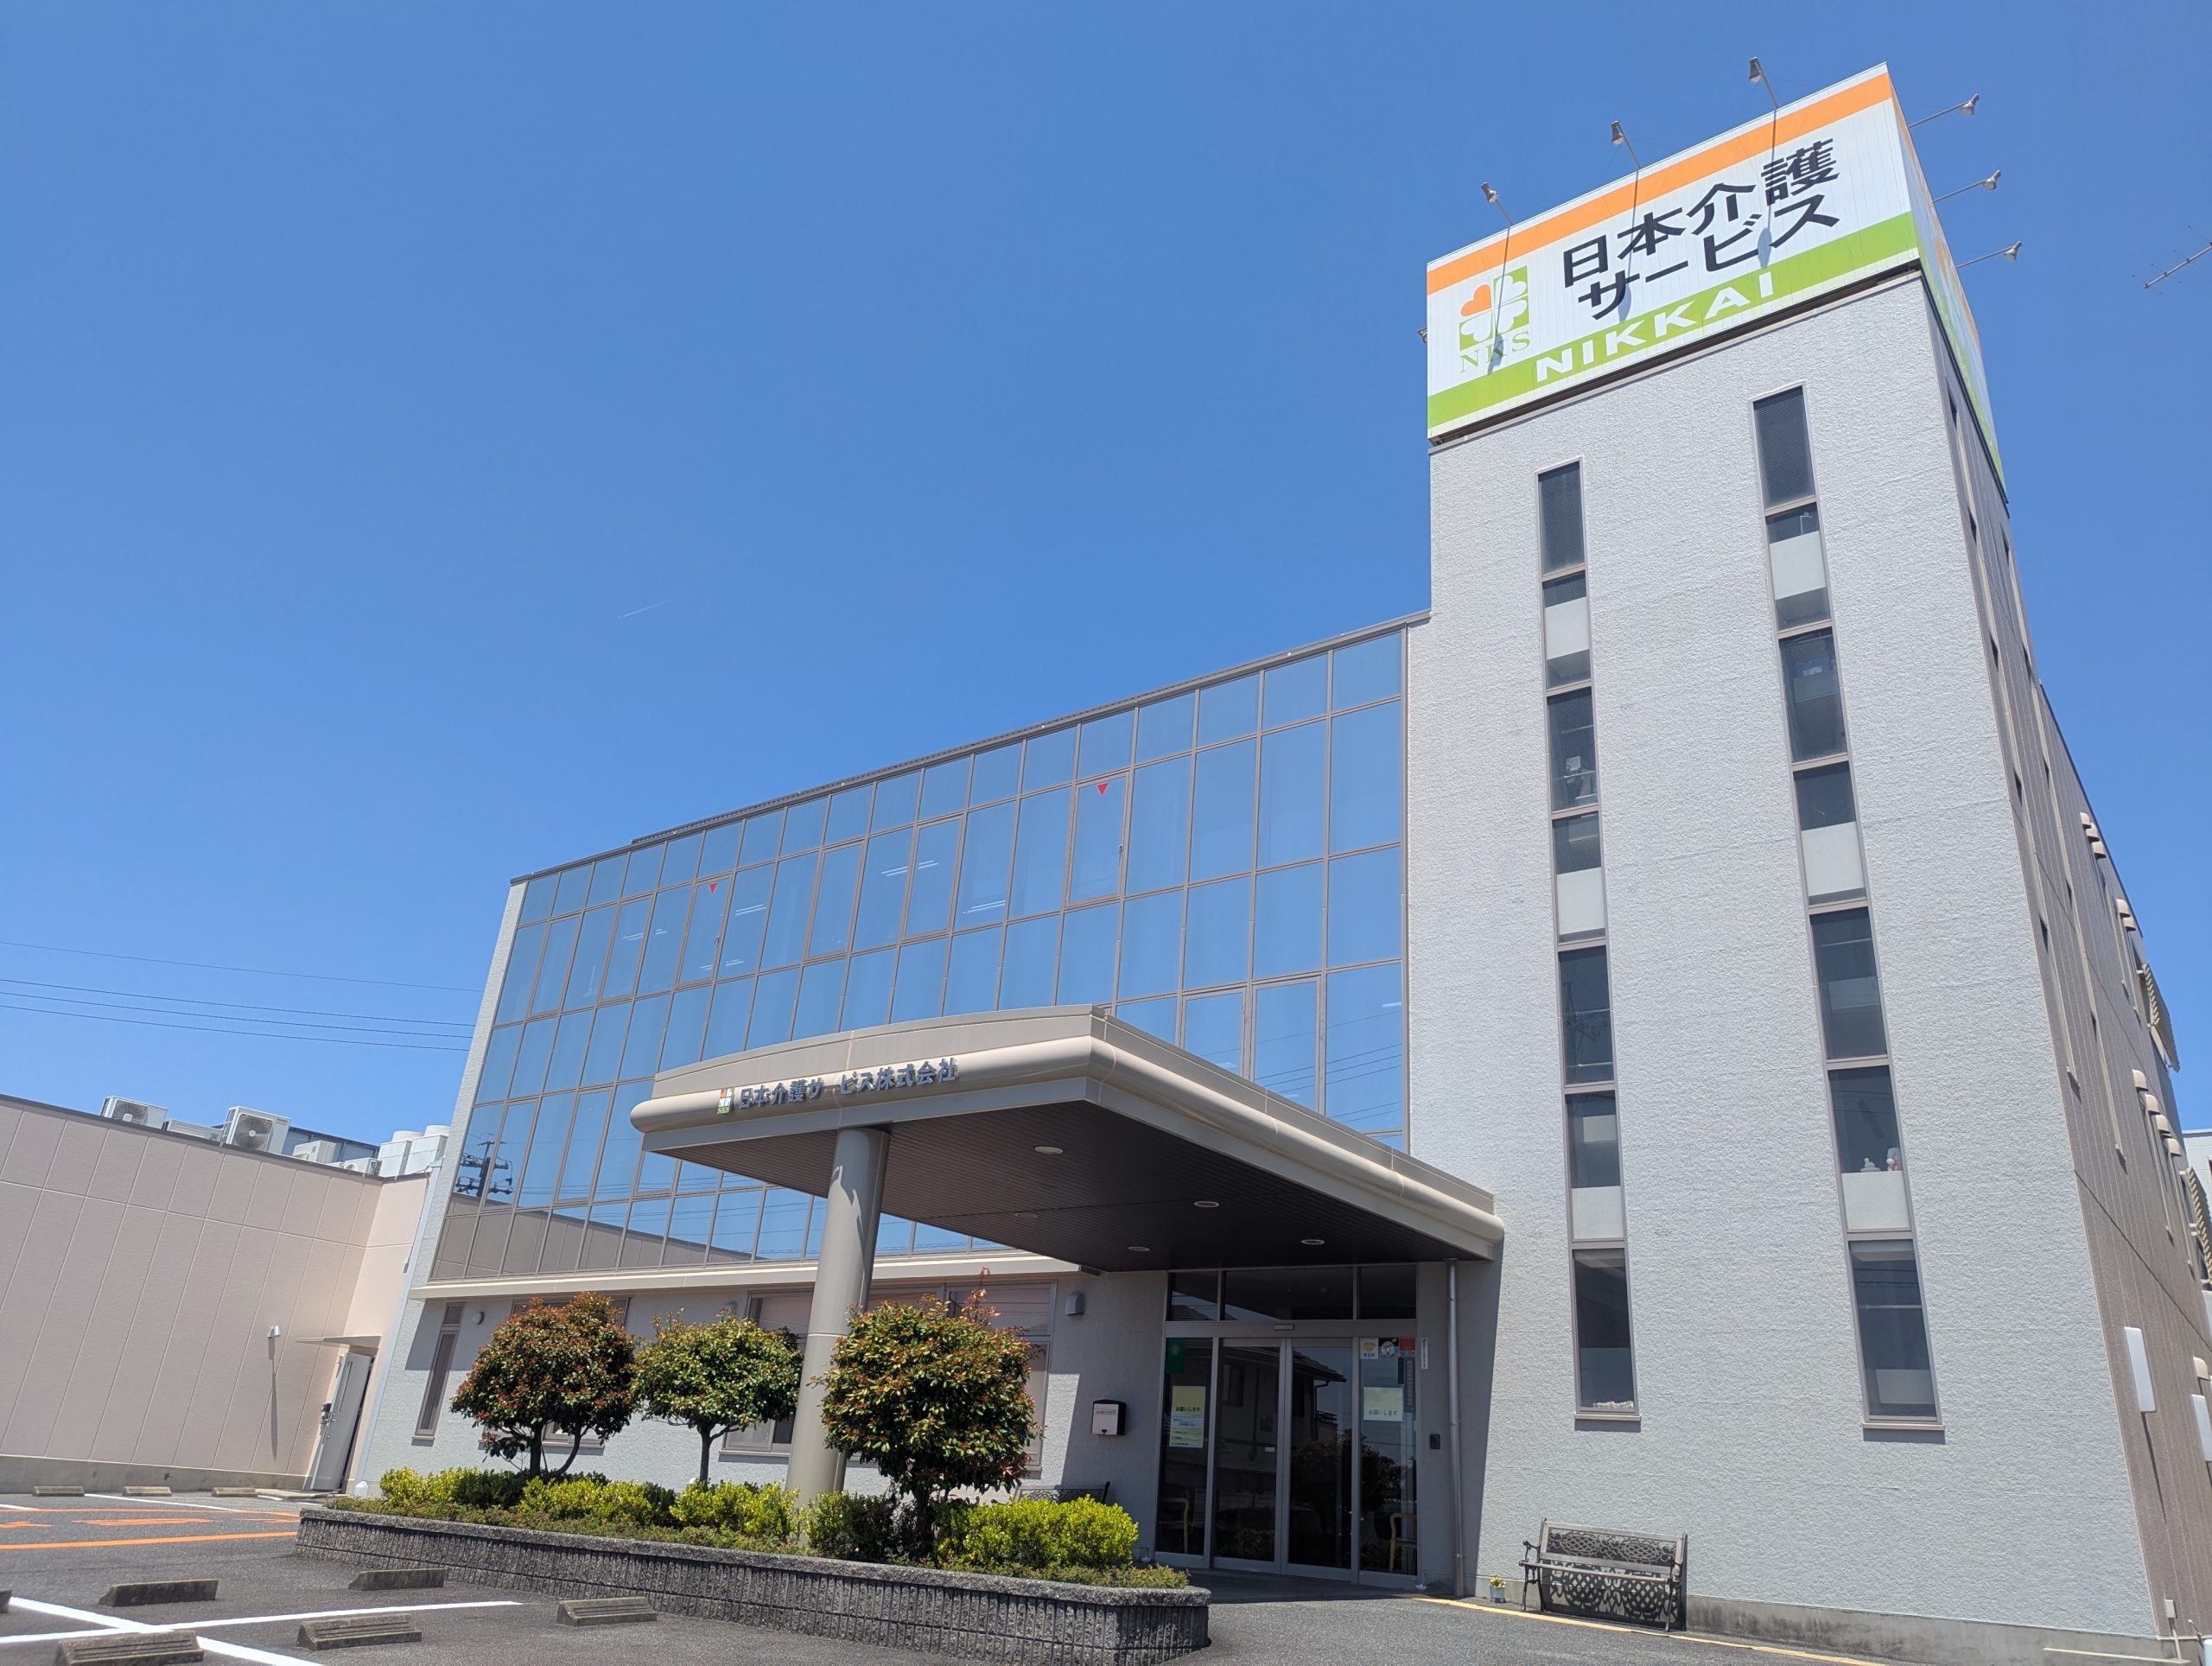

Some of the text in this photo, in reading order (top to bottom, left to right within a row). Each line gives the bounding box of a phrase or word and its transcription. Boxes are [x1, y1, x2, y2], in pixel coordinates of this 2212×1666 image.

[1563, 137, 1840, 289] 日本介護
[1578, 194, 1840, 321] サービス
[1459, 330, 1530, 373] NKS
[1536, 271, 1774, 383] NIKKAI
